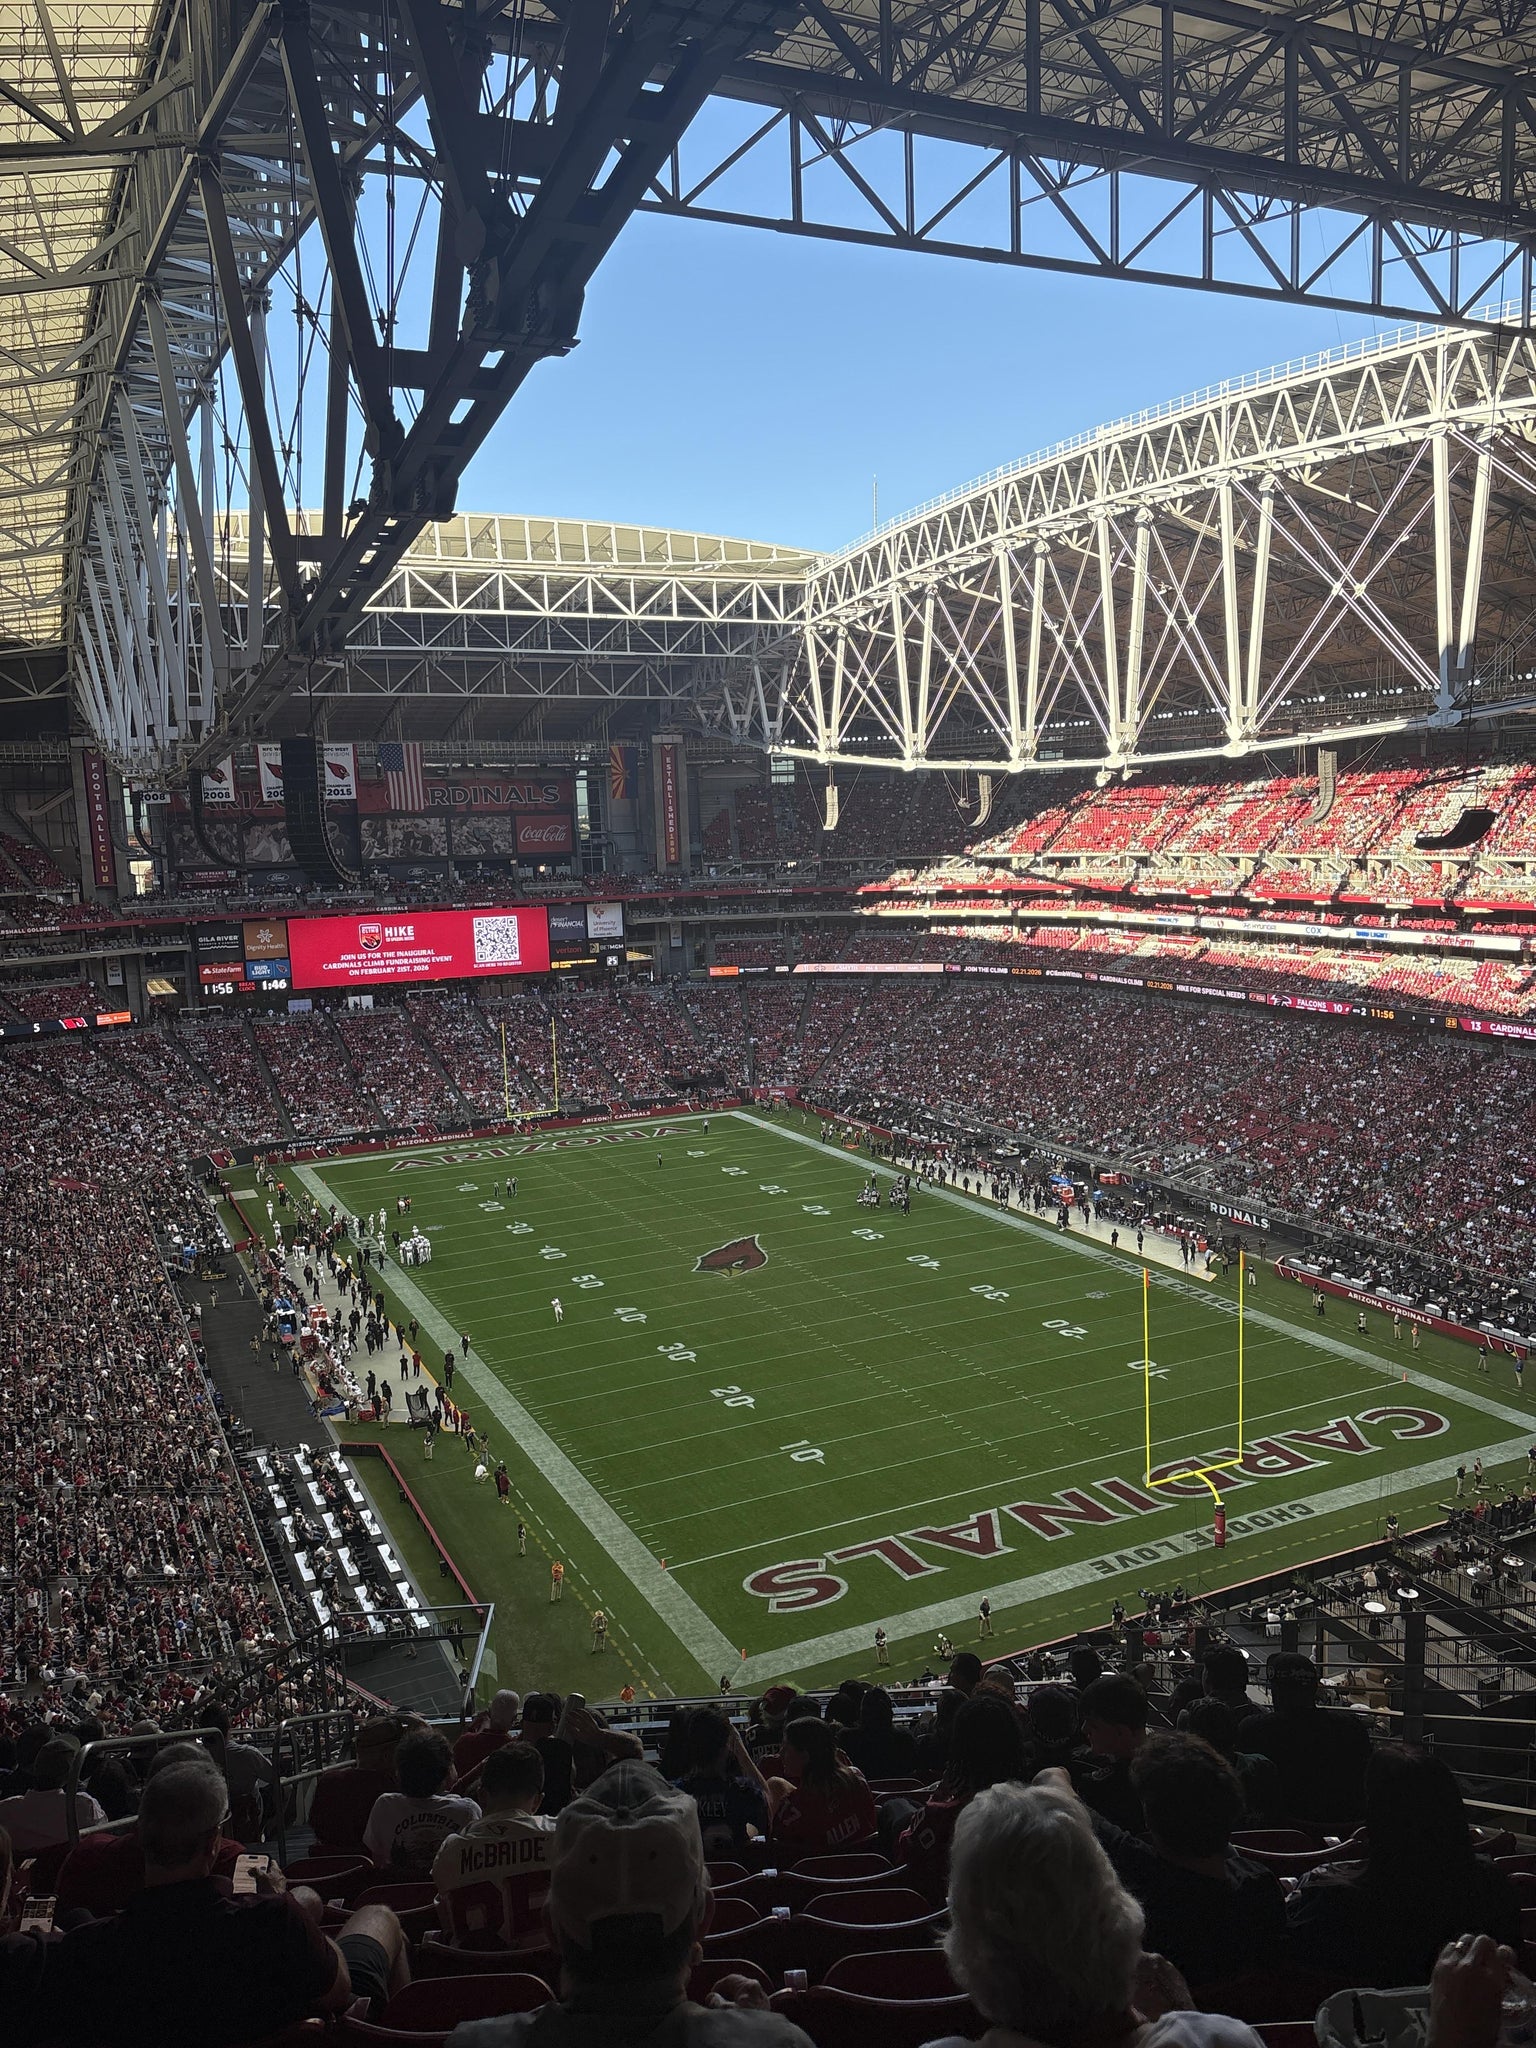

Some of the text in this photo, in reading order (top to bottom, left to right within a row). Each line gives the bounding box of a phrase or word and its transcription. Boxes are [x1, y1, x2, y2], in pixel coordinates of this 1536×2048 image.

[204, 792, 231, 800] 2008
[267, 790, 286, 798] 200
[326, 788, 352, 796] 2015
[385, 785, 560, 806] RDINALS
[665, 757, 675, 832] ESTABLISHED
[91, 762, 109, 883] FOOTBALL CLUB
[27, 925, 61, 934] GOLDBERG
[384, 925, 414, 937] HIKE
[1305, 927, 1322, 935] COX
[216, 934, 239, 942] RIVER
[1435, 935, 1475, 947] State Farm
[397, 949, 435, 957] INAUGURAL
[555, 946, 582, 954] verizon
[600, 943, 624, 951] BETMGM
[322, 961, 362, 970] CARDINALS
[385, 957, 431, 966] FUNDRAISING
[431, 955, 453, 963] EVENT
[360, 967, 395, 975] FEBRUARY
[262, 979, 287, 990] 1:46
[1099, 975, 1127, 984] CARDINALS
[1176, 984, 1190, 993] HIKE
[1190, 986, 1201, 994] FOR
[1201, 987, 1226, 997] SPECIAL
[1226, 990, 1246, 1000] NEEDS
[1297, 998, 1327, 1009] FALCONS
[1333, 1003, 1343, 1013] 10
[1370, 1008, 1395, 1020] 11:56
[1470, 1021, 1482, 1031] 13
[614, 1111, 651, 1120] CARDINALS
[287, 1136, 354, 1148] ARIZONA CARDINALS
[395, 1132, 474, 1147] ARIZONA CARDINALS
[387, 1125, 703, 1173] ARIZONA
[1034, 1148, 1270, 1229] ARIZON RDINALS
[478, 1200, 506, 1212] 20
[802, 1204, 832, 1216] 40
[505, 1221, 535, 1235] 30
[850, 1227, 885, 1241] 50
[538, 1244, 567, 1260] 40
[906, 1254, 940, 1269] 40
[570, 1273, 605, 1289] 50
[969, 1284, 1010, 1301] 30
[612, 1306, 648, 1323] 40
[1347, 1291, 1433, 1325] ARIZONA CARDINALS
[1041, 1318, 1089, 1338] 20
[656, 1342, 697, 1361] 30
[710, 1385, 755, 1407] 20
[779, 1439, 825, 1462] 10
[742, 1405, 1451, 1614] CARDINALS
[1088, 1541, 1184, 1575] LOVE
[395, 1813, 460, 1835] COLUMBIA
[826, 1813, 861, 1845] ALLEN
[460, 1837, 546, 1874] McBRIDE
